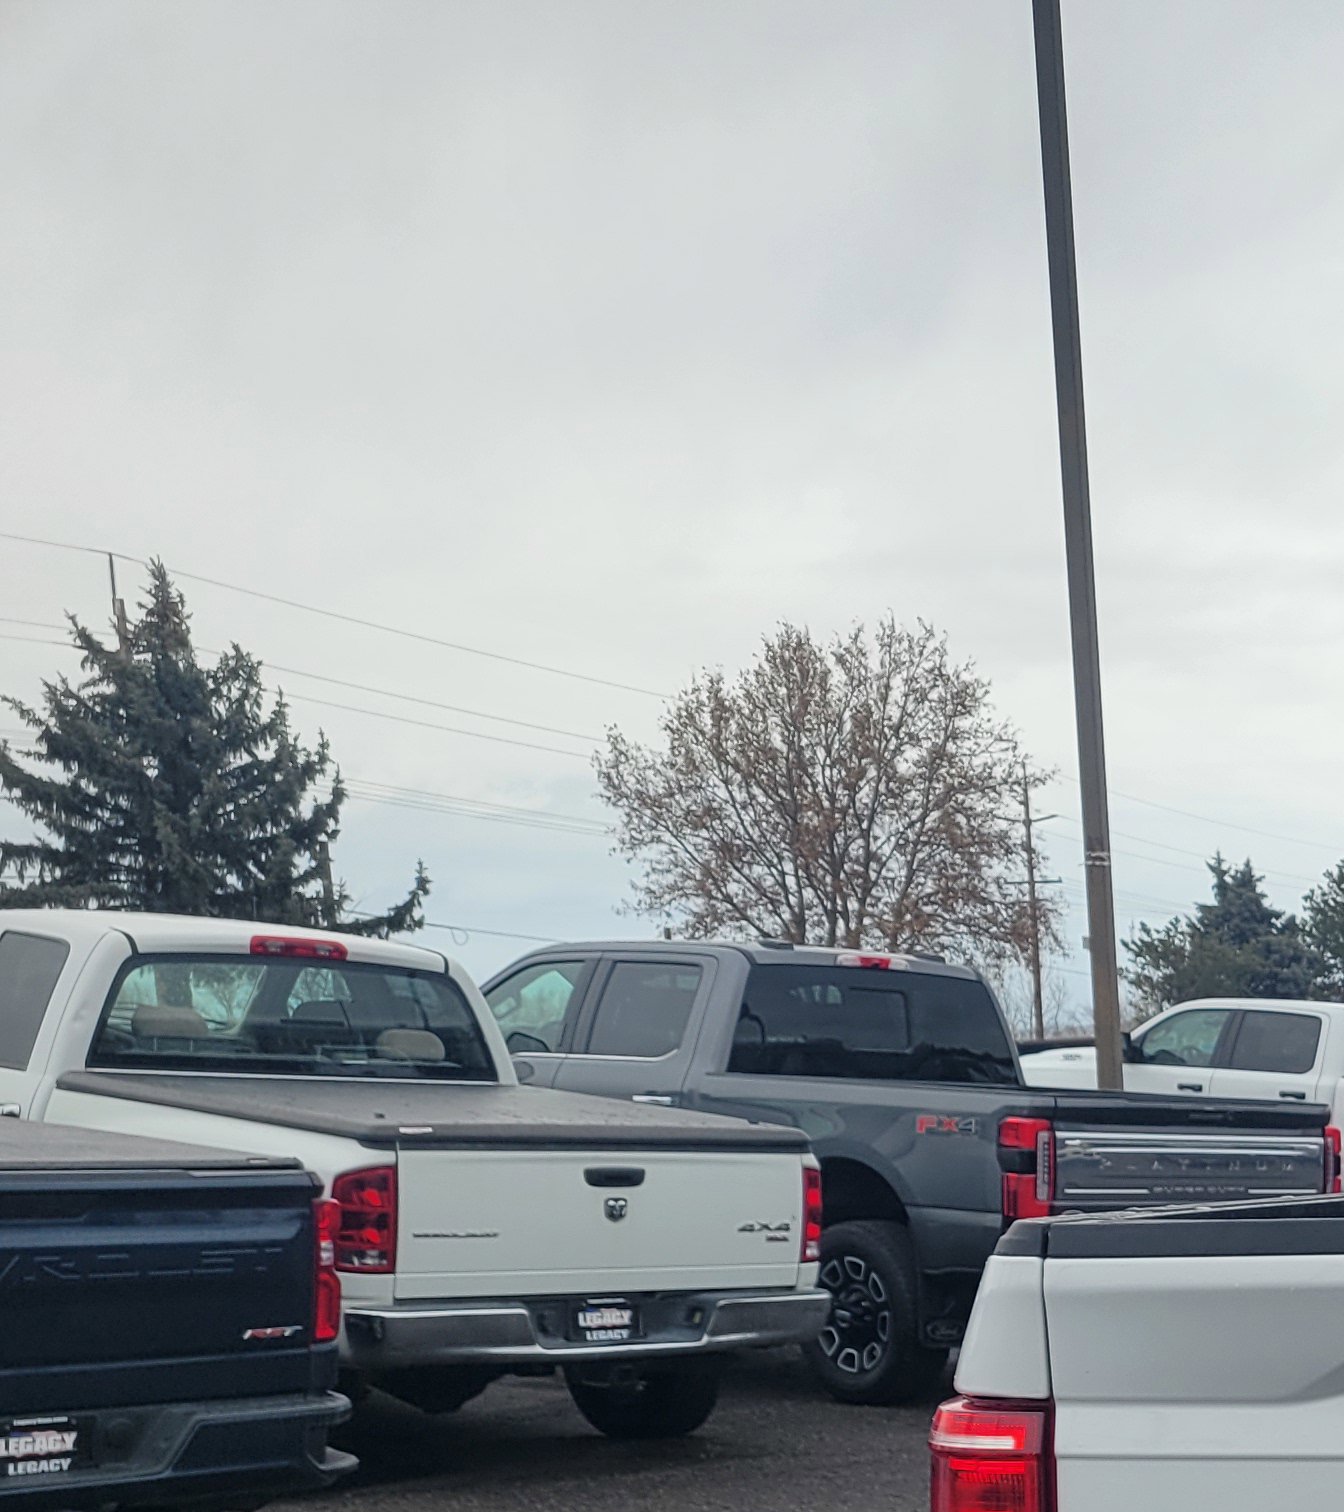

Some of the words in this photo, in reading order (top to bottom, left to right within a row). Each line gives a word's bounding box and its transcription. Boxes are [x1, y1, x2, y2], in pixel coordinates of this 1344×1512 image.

[916, 1115, 975, 1133] FX4
[578, 1308, 632, 1328] LEGACY
[585, 1328, 631, 1341] LEGACY
[0, 1431, 78, 1456] LEGACY
[8, 1458, 72, 1476] LEGACY
